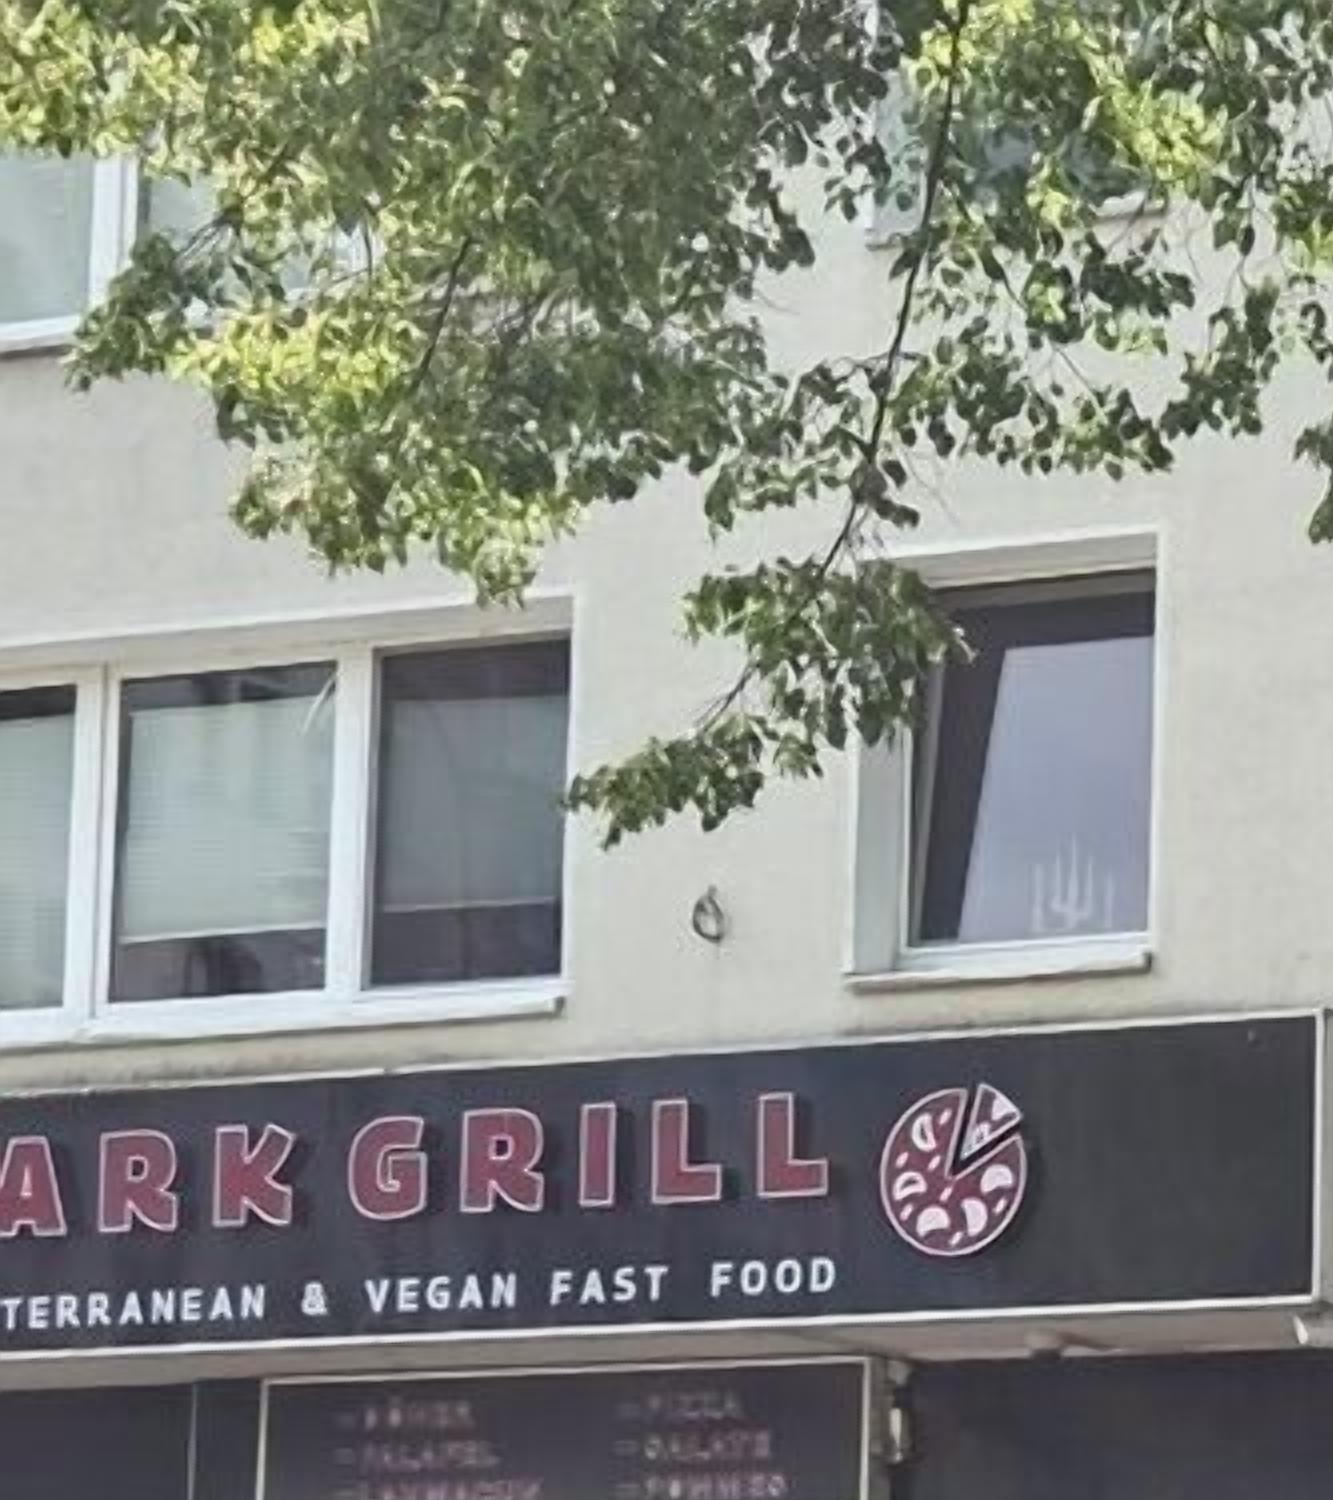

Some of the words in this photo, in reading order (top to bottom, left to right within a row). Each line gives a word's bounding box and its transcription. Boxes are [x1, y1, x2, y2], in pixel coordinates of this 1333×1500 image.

[0, 1124, 296, 1237] ARK
[348, 1091, 829, 1221] GRILL
[0, 1284, 266, 1331] TERRANEAN
[301, 1280, 329, 1315] &
[365, 1271, 517, 1313] VEGAN
[549, 1265, 669, 1304] FAST
[710, 1257, 836, 1297] FOOD
